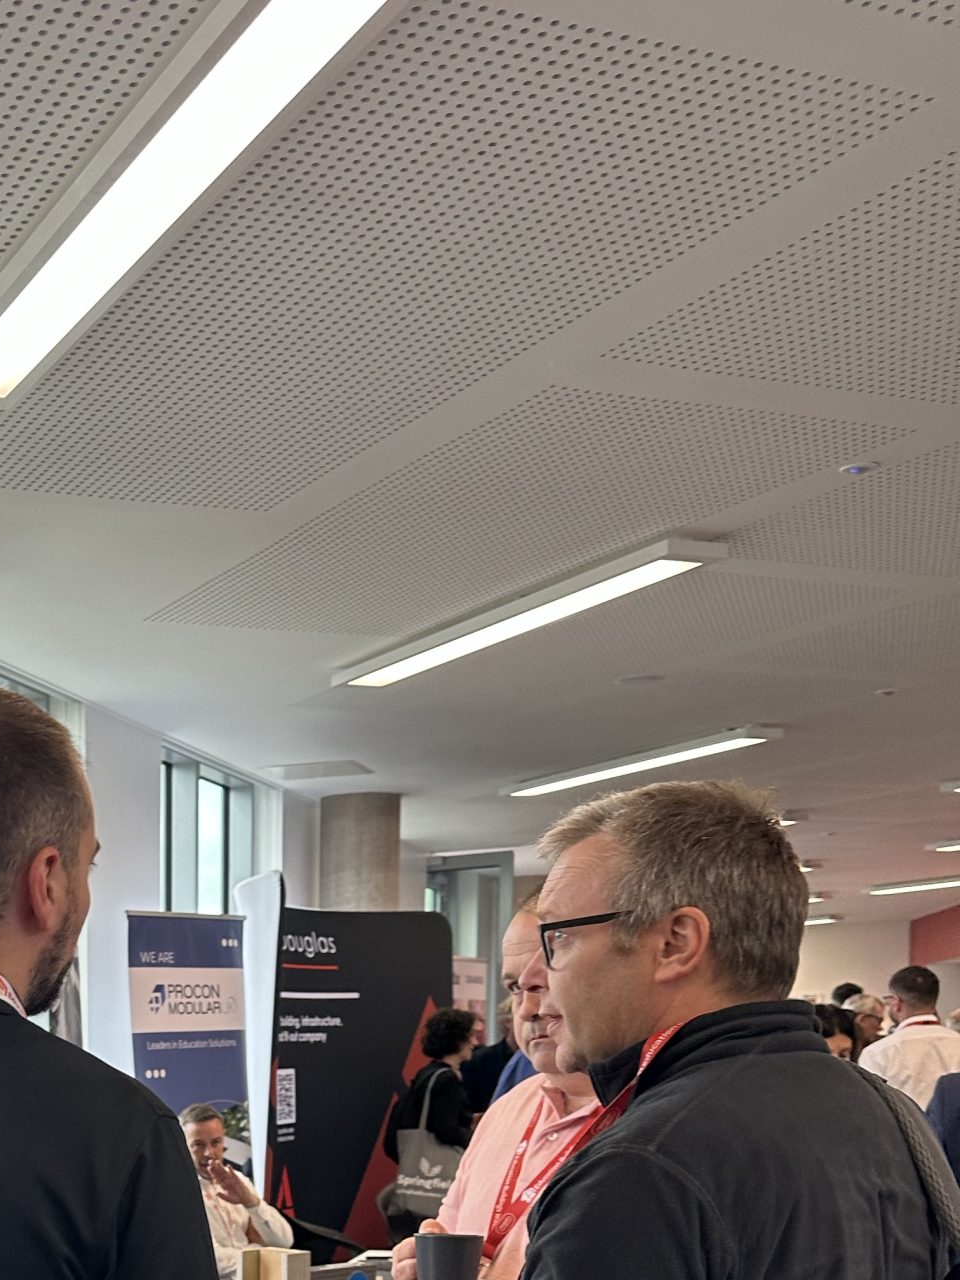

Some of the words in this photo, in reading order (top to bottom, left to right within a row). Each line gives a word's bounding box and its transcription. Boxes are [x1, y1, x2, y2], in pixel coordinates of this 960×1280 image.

[139, 951, 157, 963] WE
[158, 951, 175, 964] ARE
[167, 984, 221, 999] PROCON
[147, 1041, 171, 1051] Leaders
[178, 1039, 207, 1050] Education
[208, 1038, 237, 1048] Solutions
